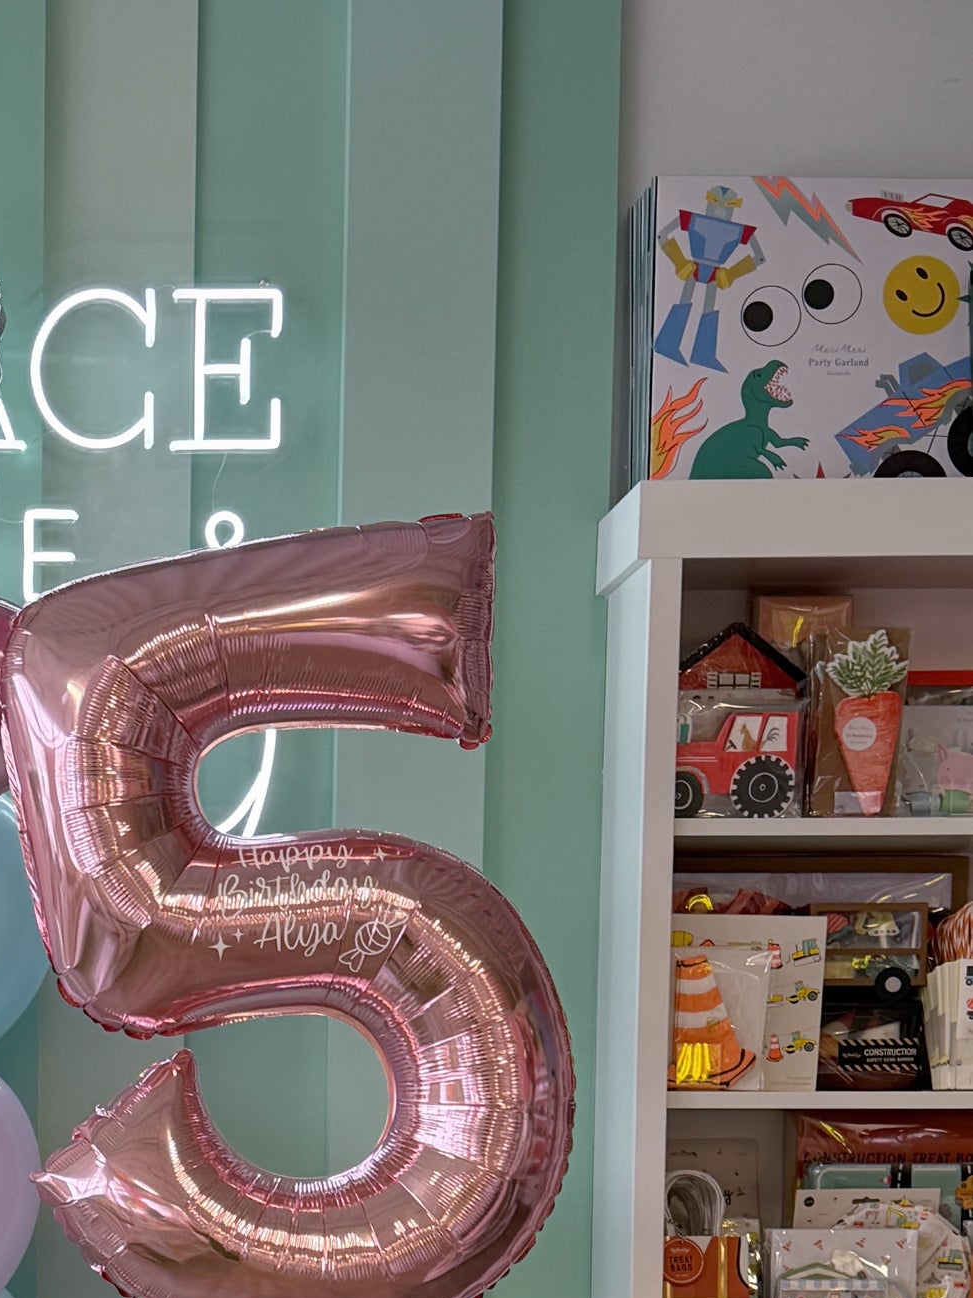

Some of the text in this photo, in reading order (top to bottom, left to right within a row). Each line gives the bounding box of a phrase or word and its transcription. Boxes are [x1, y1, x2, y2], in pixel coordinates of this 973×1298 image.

[808, 357, 869, 368] Party Garland
[232, 843, 354, 873] Happy
[218, 869, 379, 921] Birthday
[863, 1048, 917, 1056] CONSTRUCTION
[803, 1152, 906, 1164] CONSTRUCTION
[912, 1152, 951, 1163] TREAT
[669, 1256, 693, 1264] TREAT
[670, 1264, 693, 1272] BAGS
